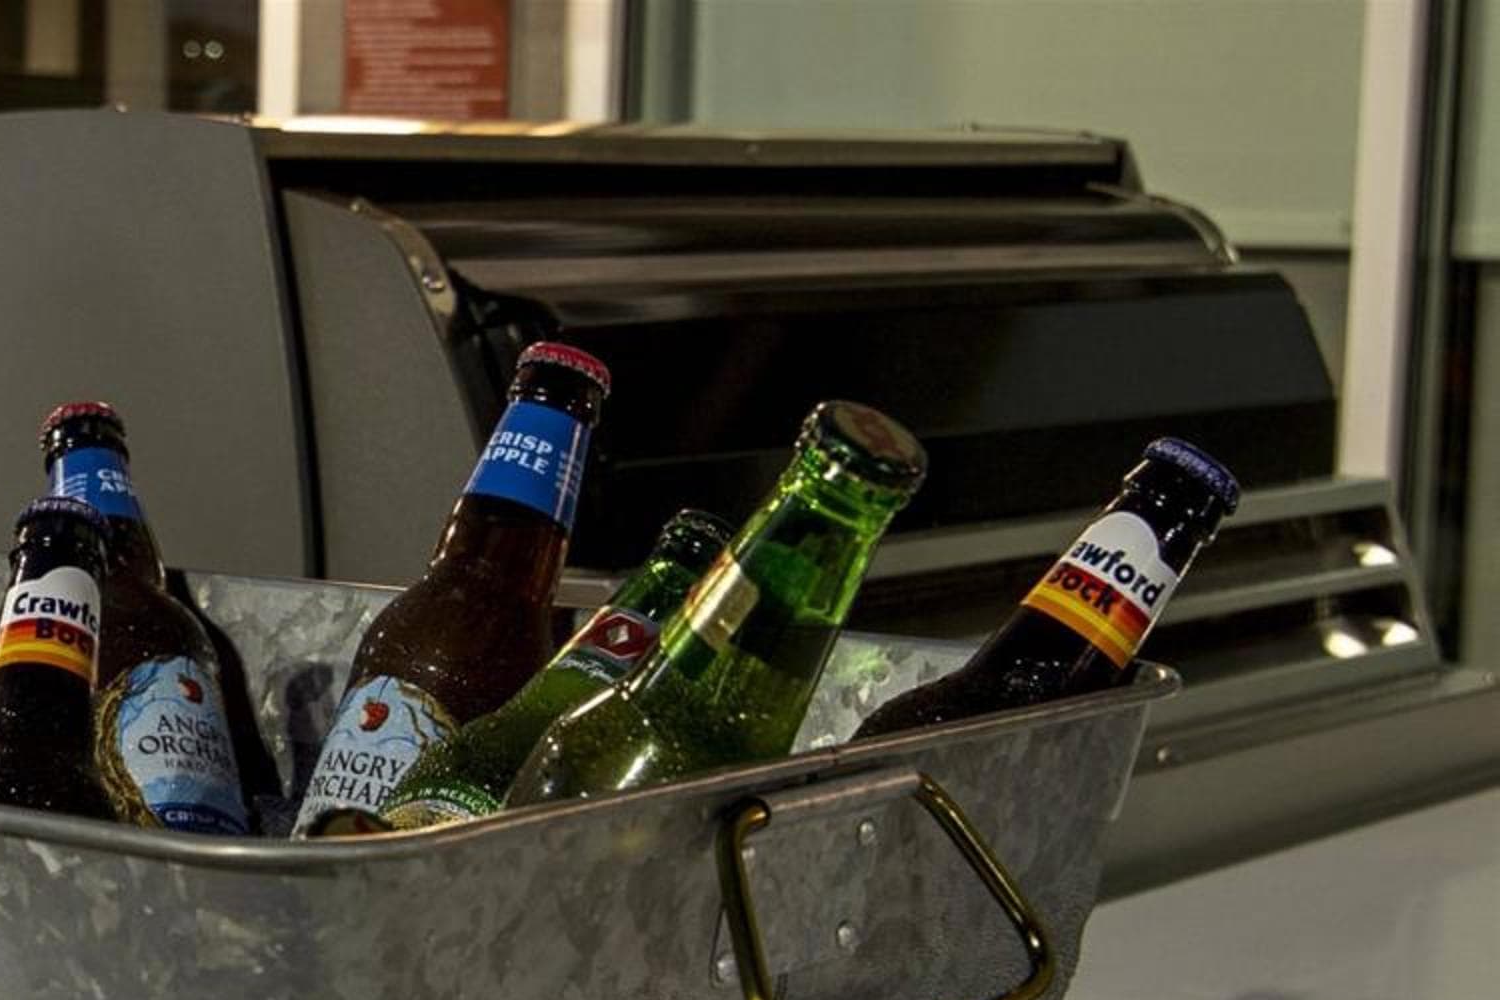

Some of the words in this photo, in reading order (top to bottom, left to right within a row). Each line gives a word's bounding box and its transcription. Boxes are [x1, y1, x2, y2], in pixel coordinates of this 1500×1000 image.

[490, 431, 553, 455] CRISP
[483, 446, 550, 475] APPLE
[157, 714, 227, 745] ANG
[324, 750, 405, 784] ANGRY
